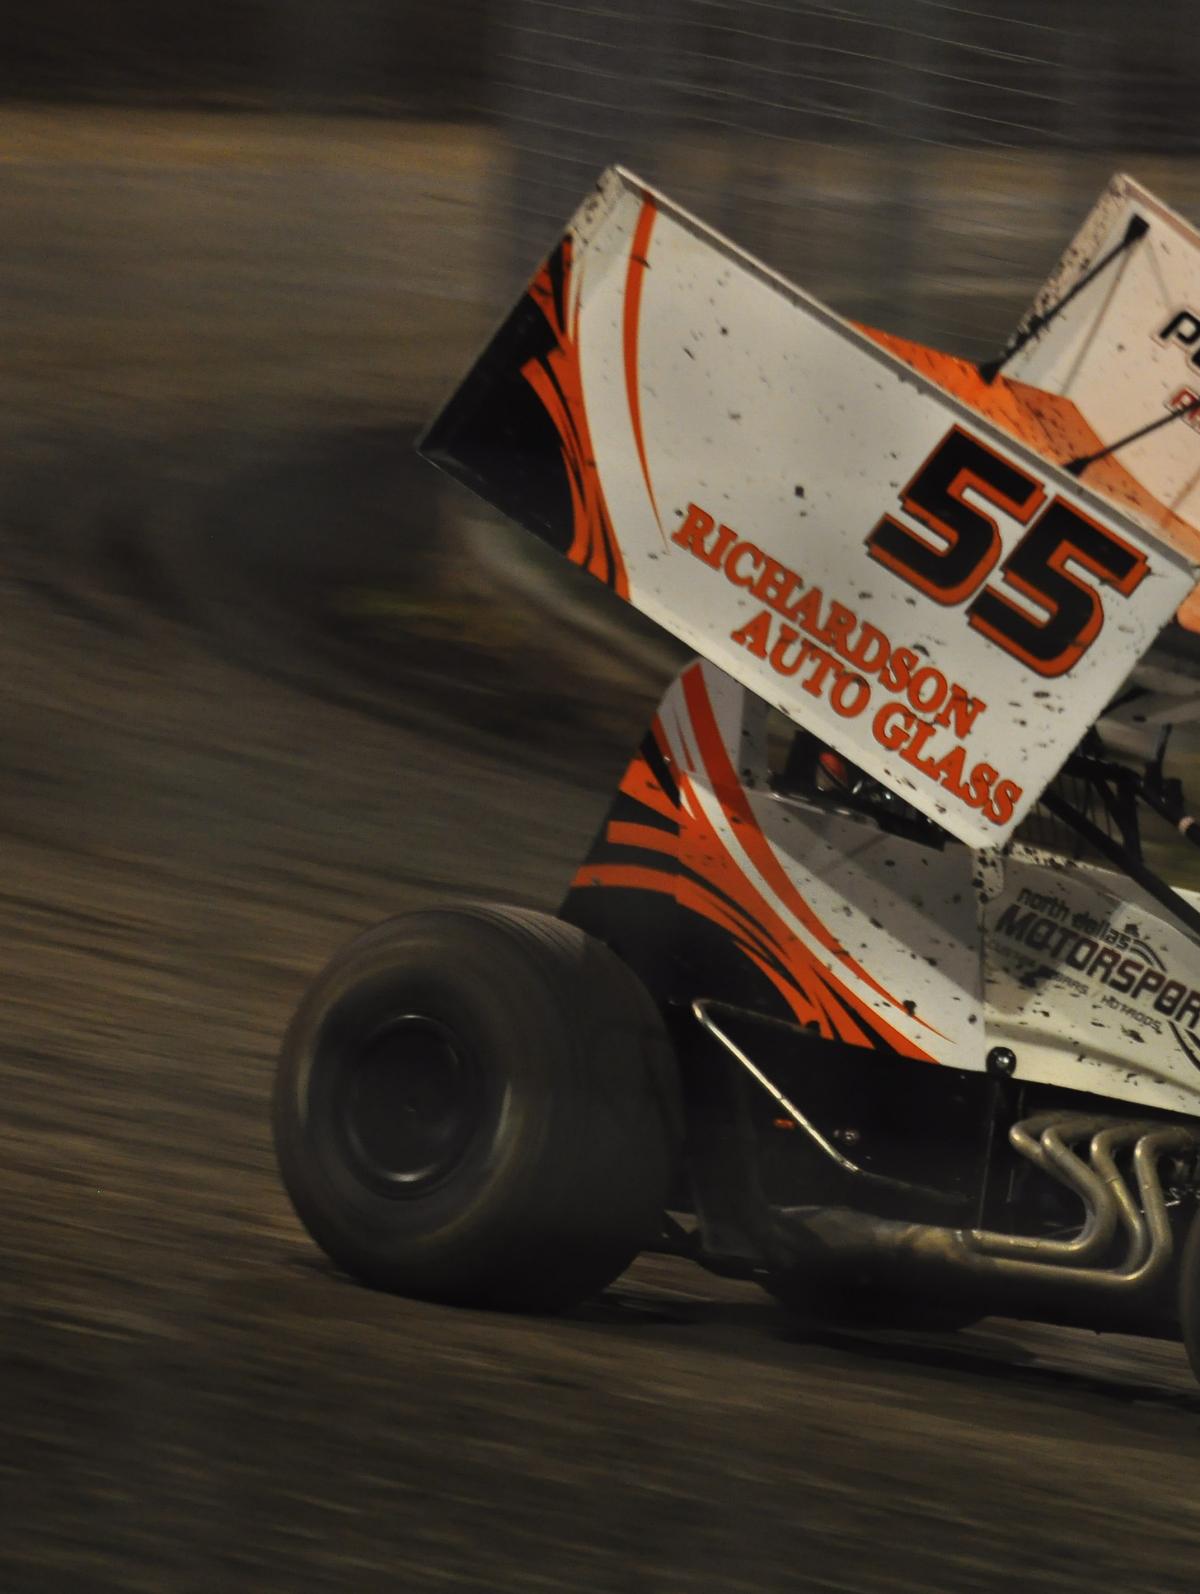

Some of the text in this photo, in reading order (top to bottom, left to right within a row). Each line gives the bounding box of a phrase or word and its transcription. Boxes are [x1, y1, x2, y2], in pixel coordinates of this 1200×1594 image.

[672, 503, 986, 739] RICHARDSON
[864, 423, 1151, 678] 55
[730, 611, 1023, 825] AUTO GLASS
